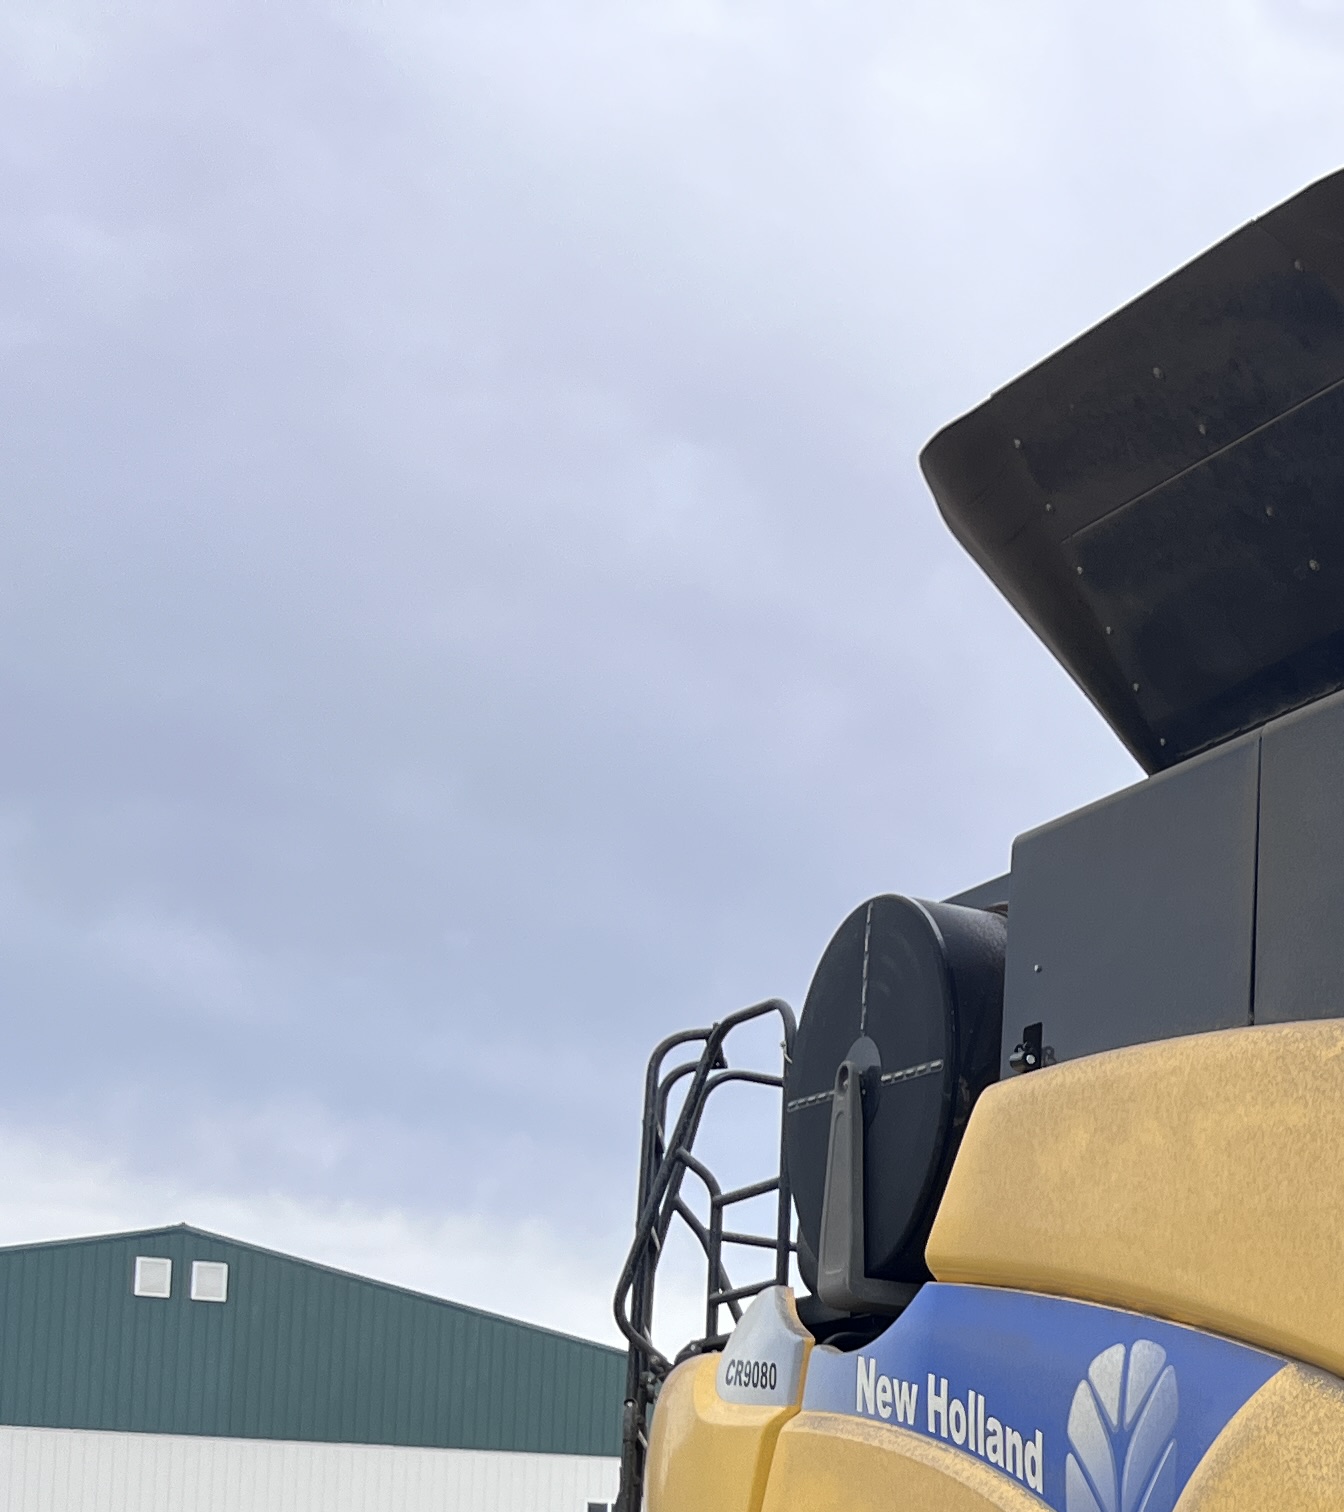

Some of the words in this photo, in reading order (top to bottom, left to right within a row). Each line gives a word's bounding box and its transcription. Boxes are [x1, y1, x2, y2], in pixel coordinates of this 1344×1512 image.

[725, 1359, 777, 1390] CR9080
[856, 1355, 918, 1426] New
[927, 1373, 1044, 1495] Holland
